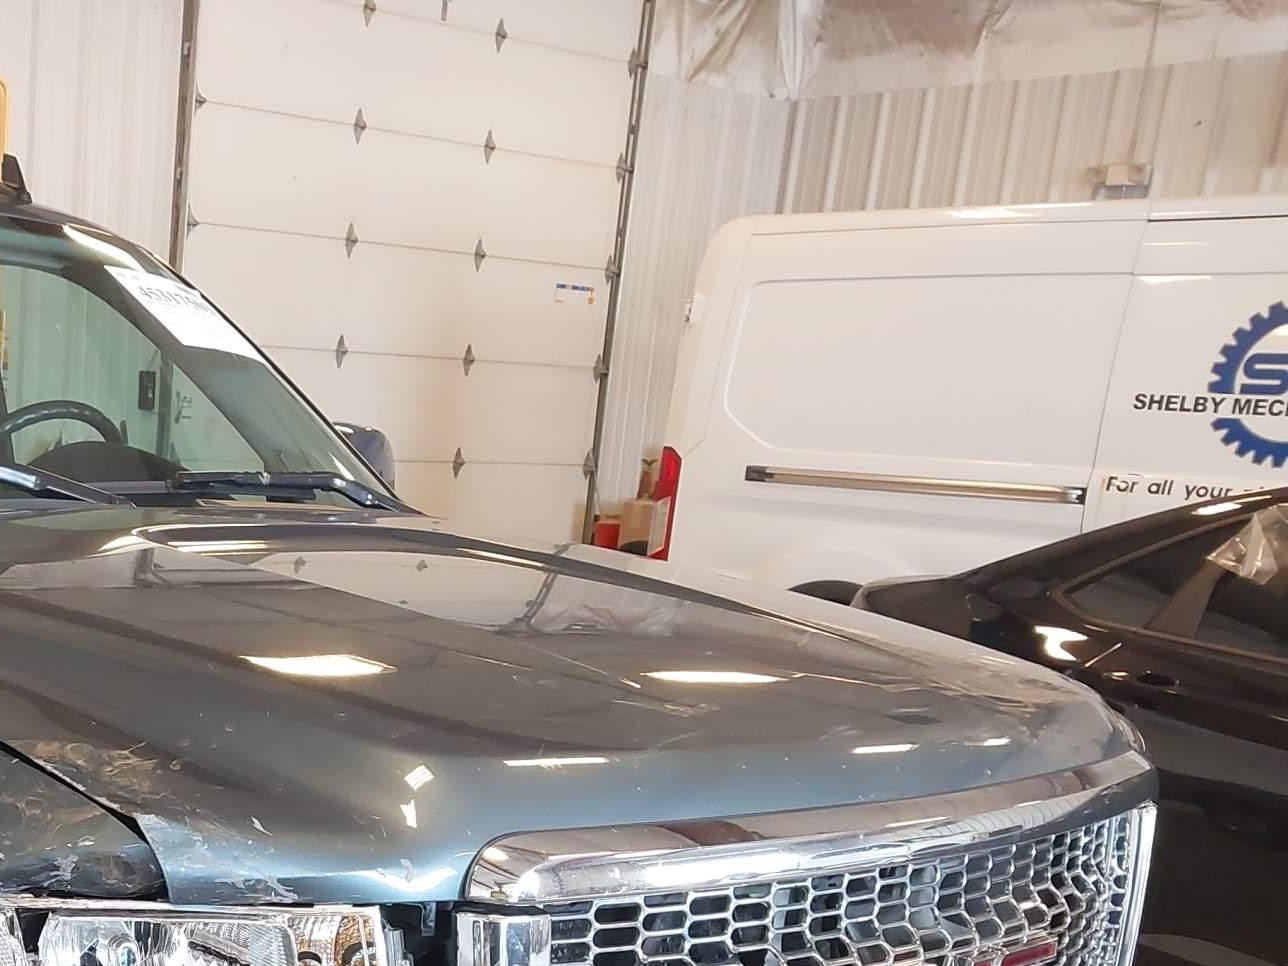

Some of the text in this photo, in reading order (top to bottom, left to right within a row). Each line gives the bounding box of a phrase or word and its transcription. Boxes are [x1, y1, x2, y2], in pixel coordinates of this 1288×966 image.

[1133, 393, 1288, 417] SHELBY MEC
[1105, 475, 1138, 494] For
[1147, 479, 1174, 496] all
[1184, 484, 1234, 501] your
